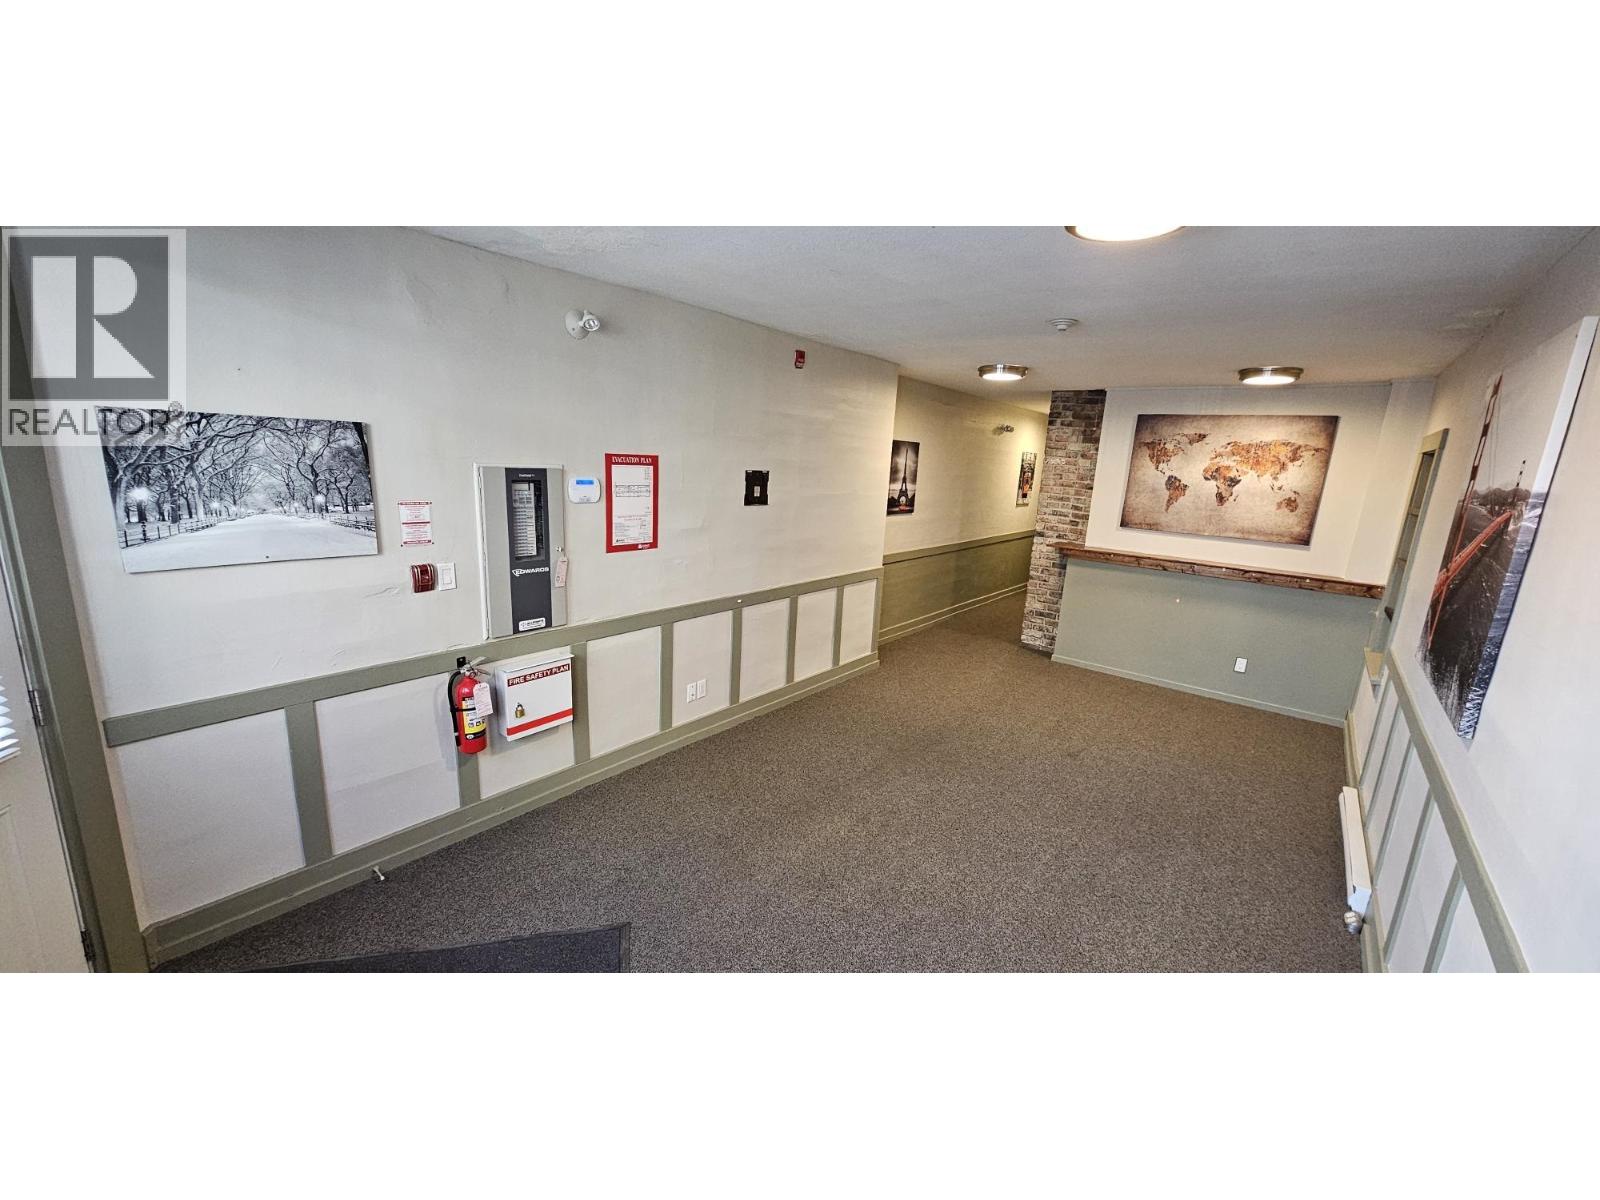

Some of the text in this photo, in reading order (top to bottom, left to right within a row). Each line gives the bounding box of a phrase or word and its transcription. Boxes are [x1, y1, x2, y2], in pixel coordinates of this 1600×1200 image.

[512, 567, 550, 577] EDWARDS
[509, 664, 569, 686] FIRE SAFETY PLAN
